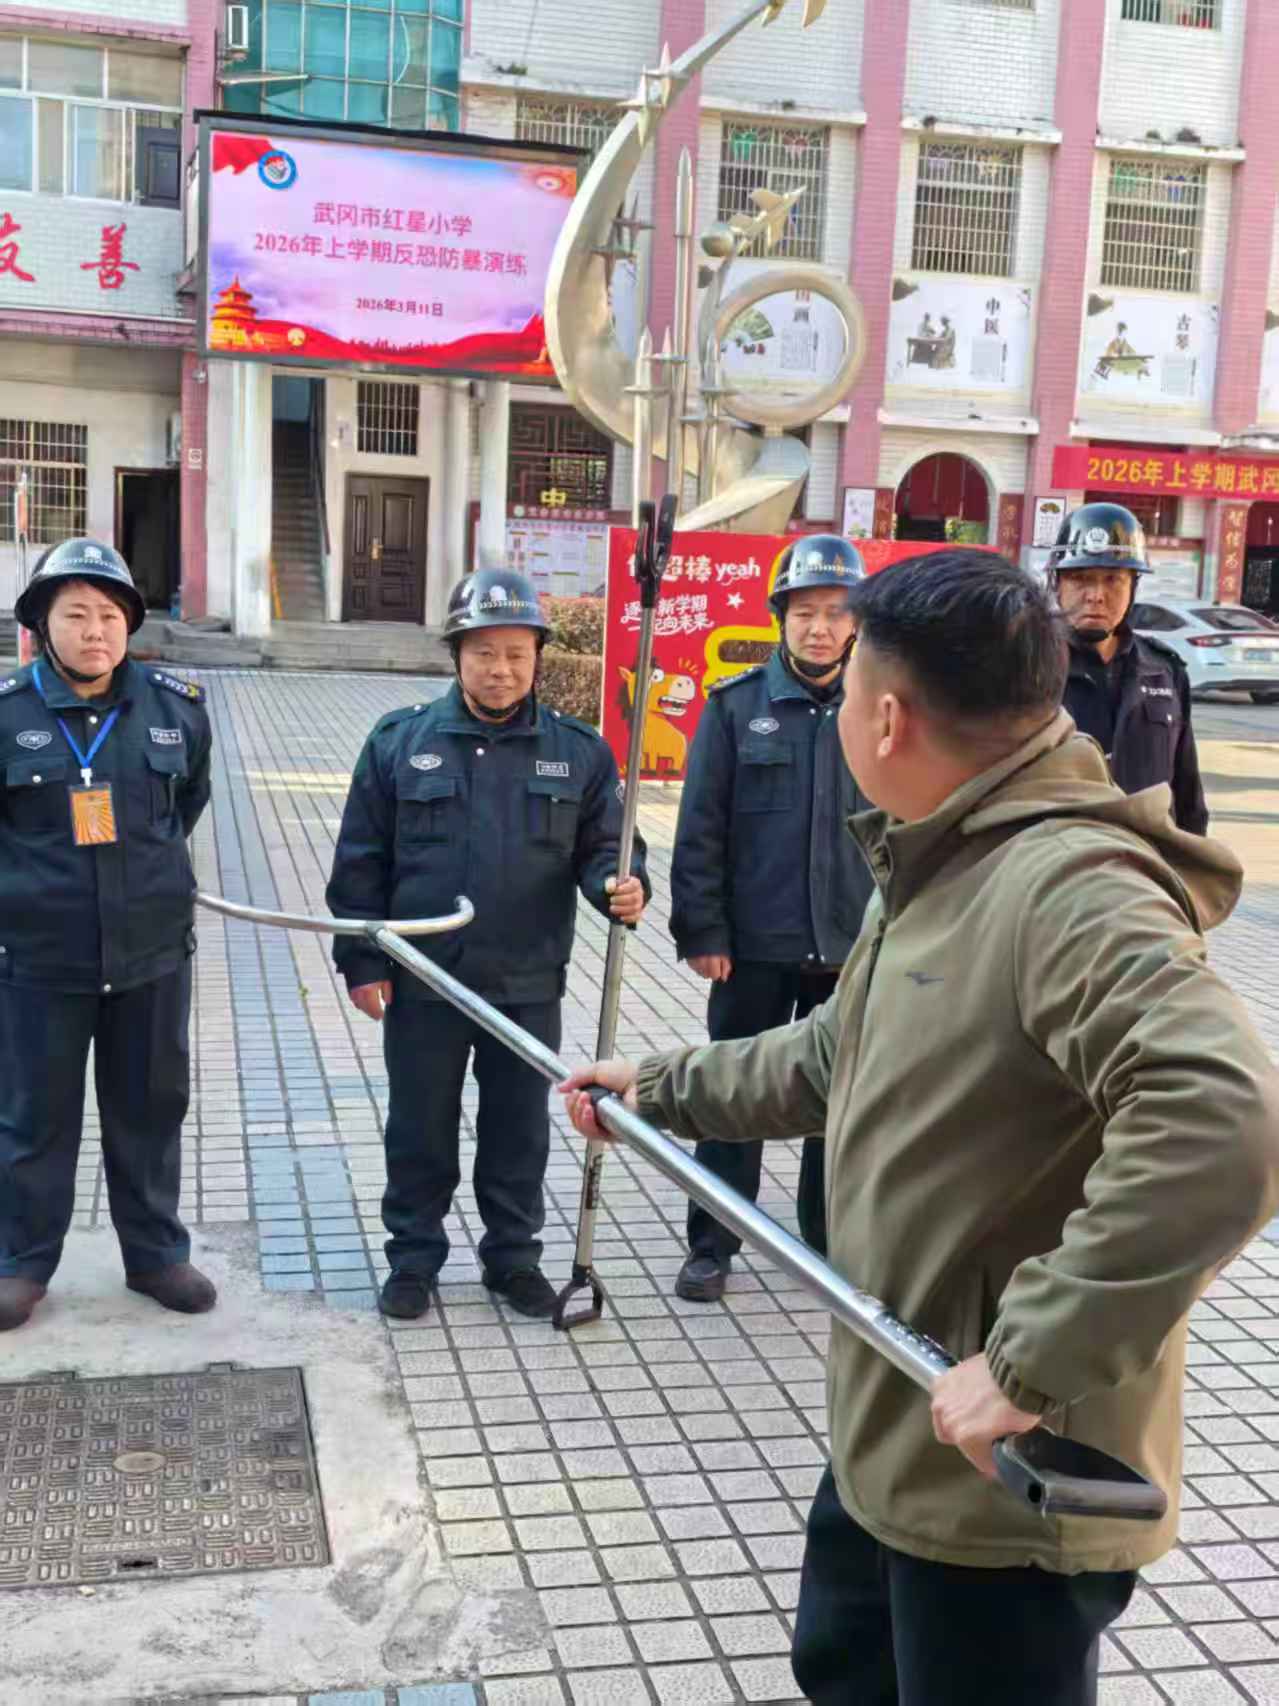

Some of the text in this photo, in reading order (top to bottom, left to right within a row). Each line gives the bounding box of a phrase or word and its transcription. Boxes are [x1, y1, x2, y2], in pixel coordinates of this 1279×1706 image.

[313, 202, 473, 237] 武冈市红星小学
[254, 233, 527, 275] 2026年上学期反恐防暴演练
[356, 297, 443, 317] 2026年3月11日
[984, 297, 1001, 336] 中医
[1087, 457, 1279, 493] 2026年上学期武冈
[715, 557, 761, 586] yeah
[621, 594, 708, 624] 逐新学期
